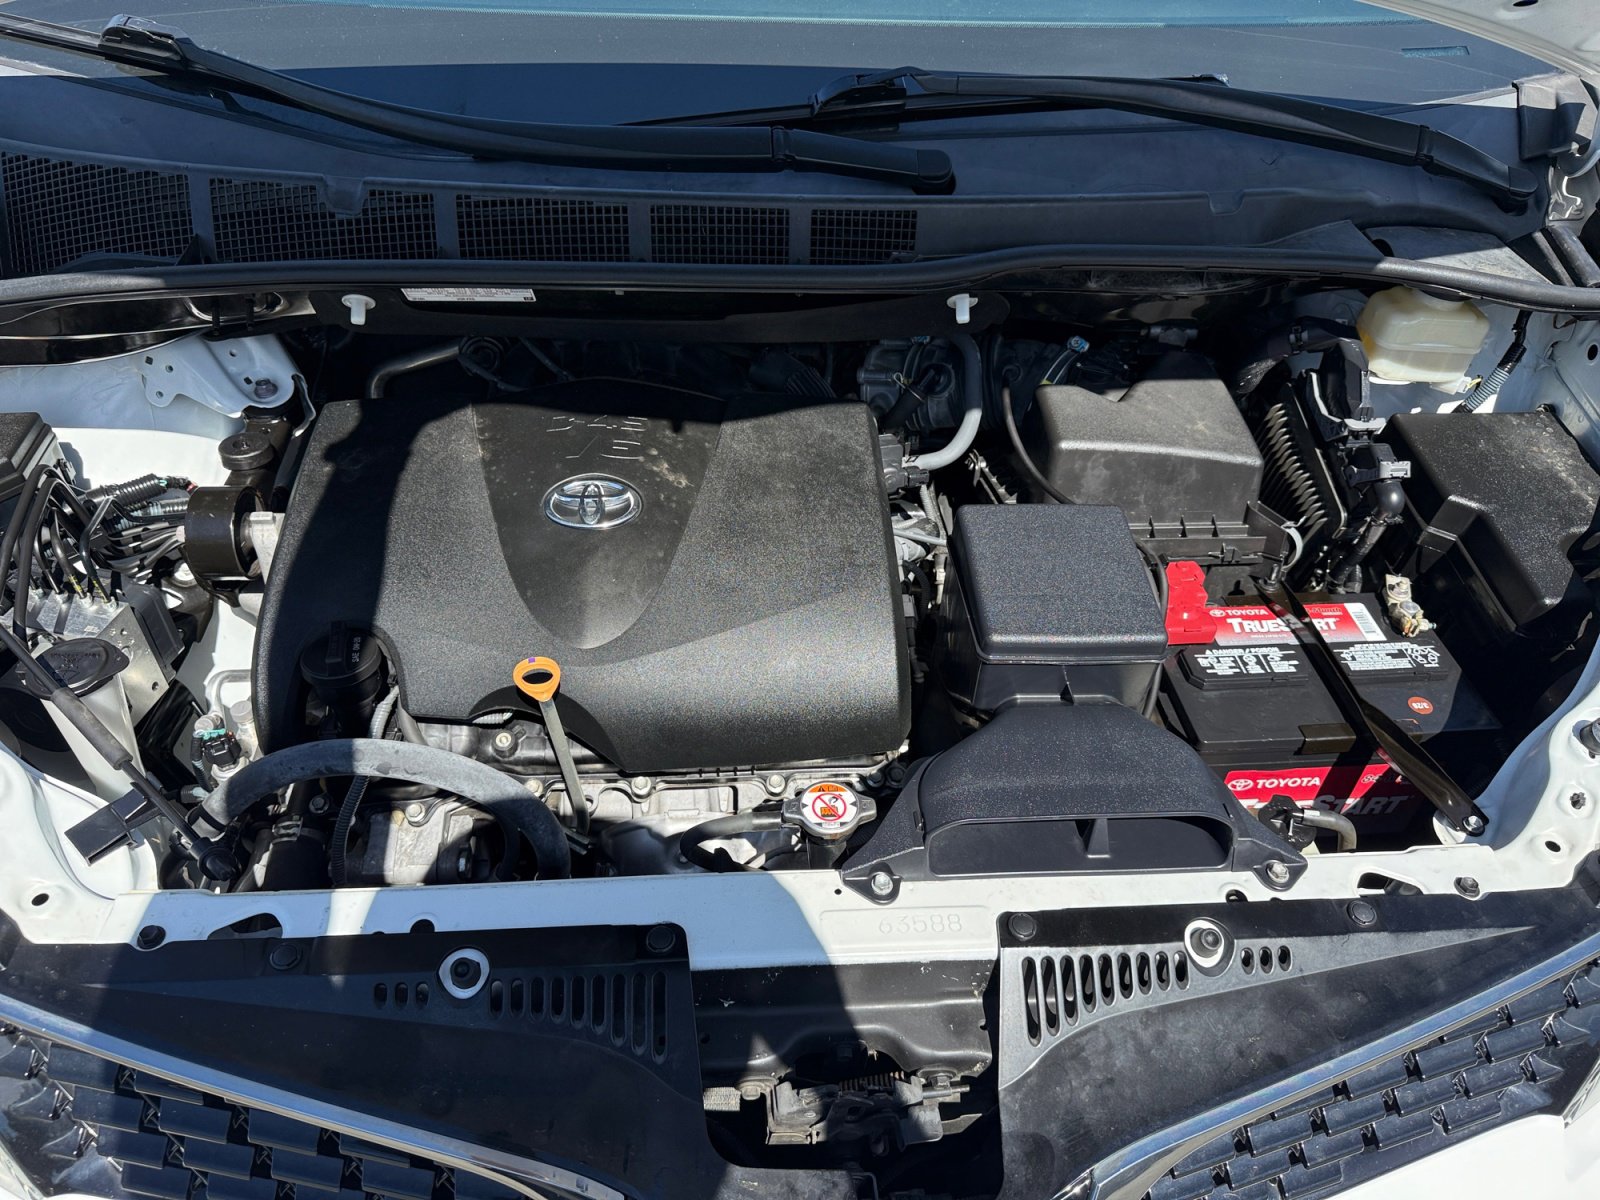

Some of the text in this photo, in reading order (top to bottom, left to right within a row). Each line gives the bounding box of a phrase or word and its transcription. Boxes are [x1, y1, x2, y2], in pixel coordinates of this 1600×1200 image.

[351, 652, 360, 663] SAE
[1256, 776, 1321, 789] TOYOTA
[879, 913, 962, 934] 63588
